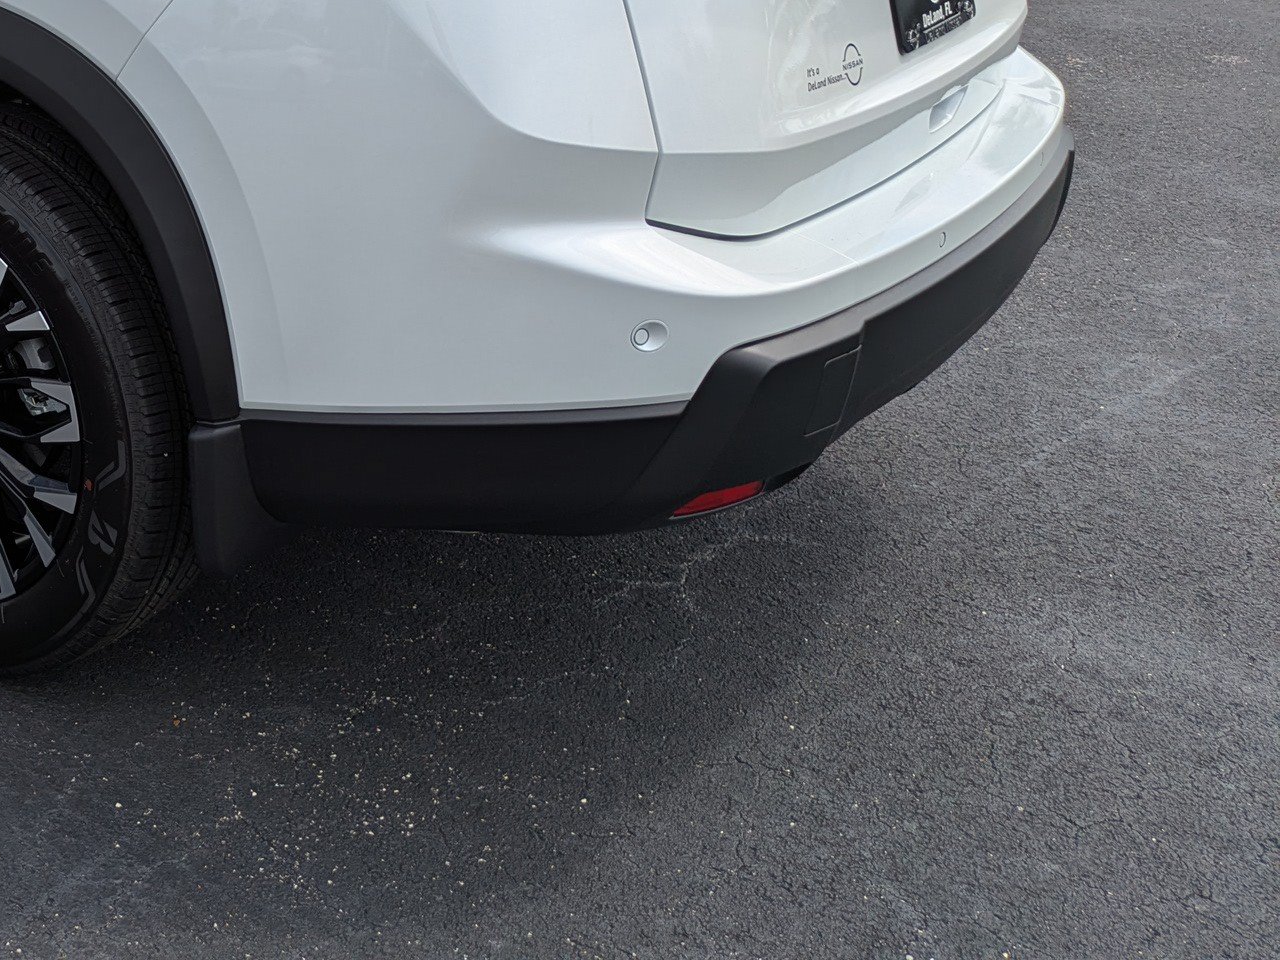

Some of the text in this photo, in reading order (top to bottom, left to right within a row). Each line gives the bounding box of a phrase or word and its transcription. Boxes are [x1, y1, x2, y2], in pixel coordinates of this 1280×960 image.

[842, 58, 863, 71] NISSAN
[806, 67, 815, 78] It's
[808, 77, 826, 92] DeLand
